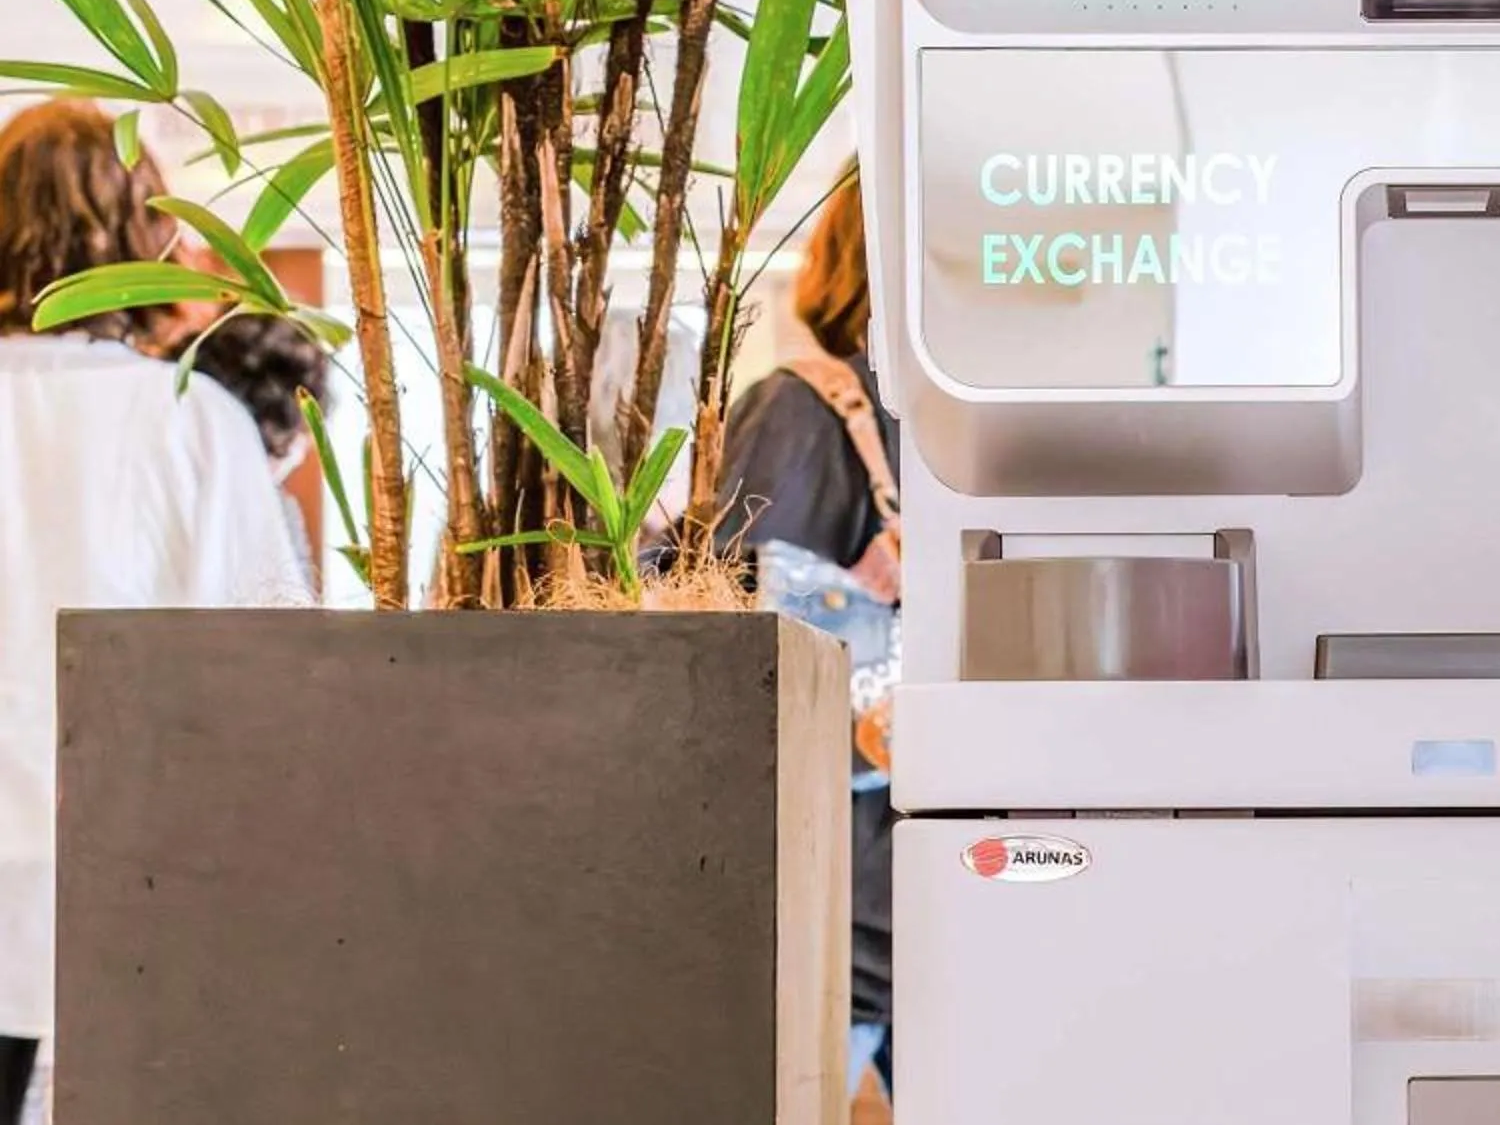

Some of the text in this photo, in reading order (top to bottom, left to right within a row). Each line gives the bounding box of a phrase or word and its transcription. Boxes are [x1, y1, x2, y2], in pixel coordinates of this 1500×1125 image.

[980, 153, 1279, 206] CURRENCY
[983, 232, 1282, 286] EXCHANGE
[1013, 851, 1083, 865] ARUNAS
